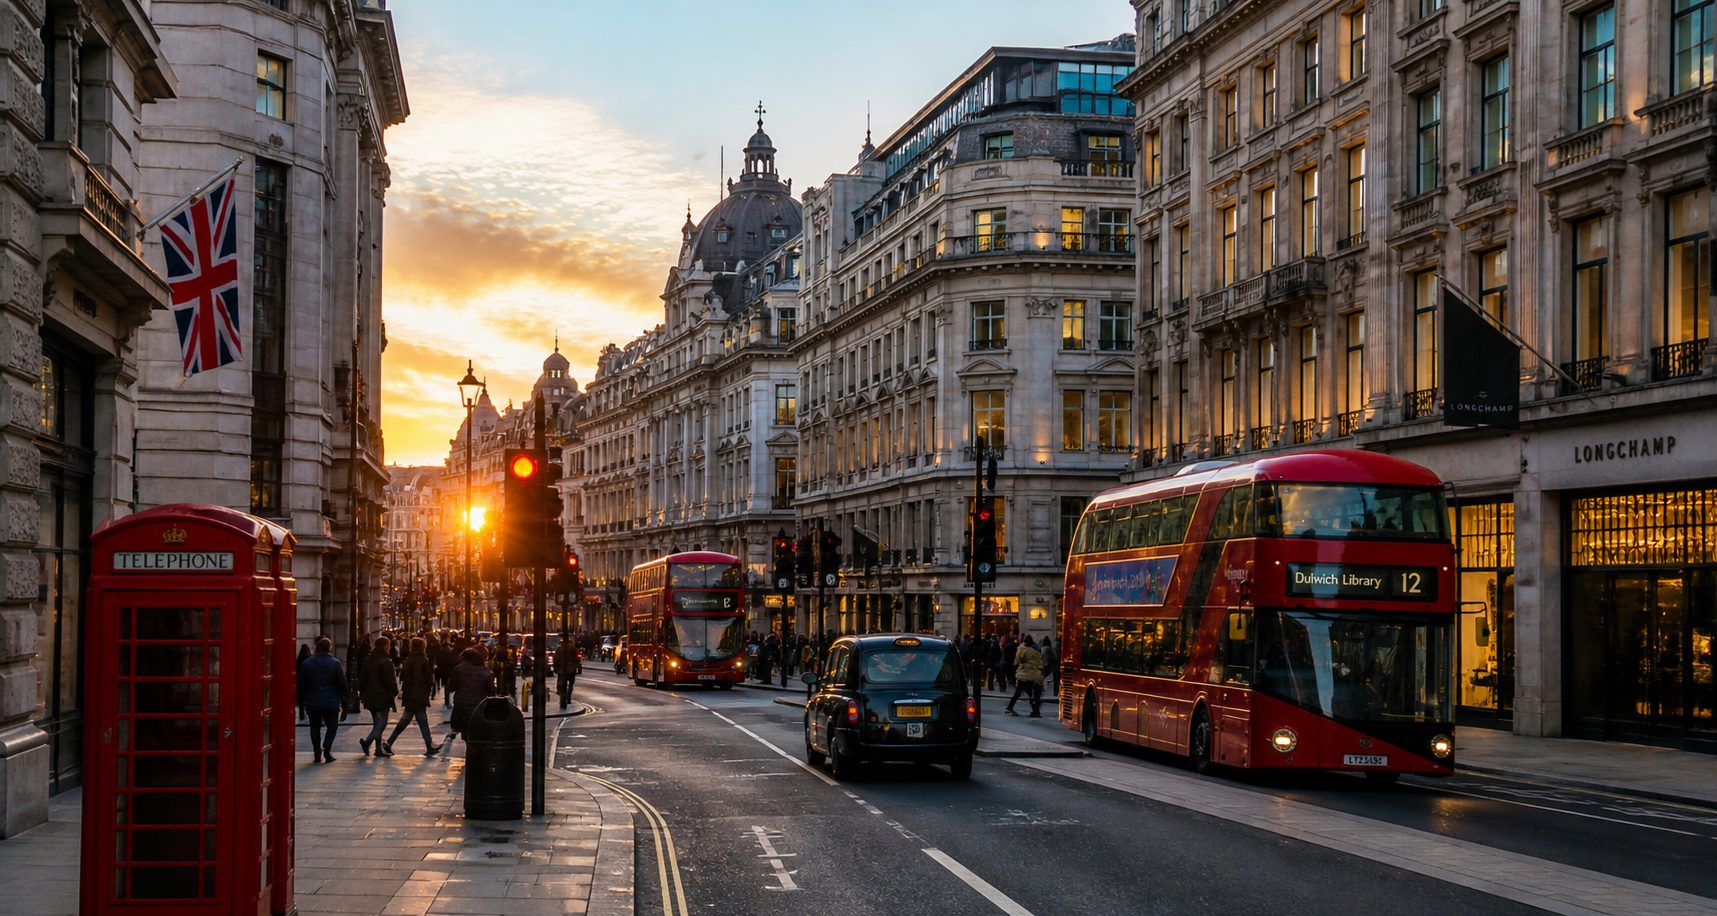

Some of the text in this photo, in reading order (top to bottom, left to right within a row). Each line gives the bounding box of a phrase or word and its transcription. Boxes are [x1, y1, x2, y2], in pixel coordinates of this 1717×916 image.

[1450, 403, 1514, 412] LONGCHAMP
[1574, 435, 1677, 464] LONGCHAMP
[118, 553, 229, 569] TELEPHONE
[1295, 571, 1381, 589] Dulwich Library
[1401, 572, 1421, 593] 12
